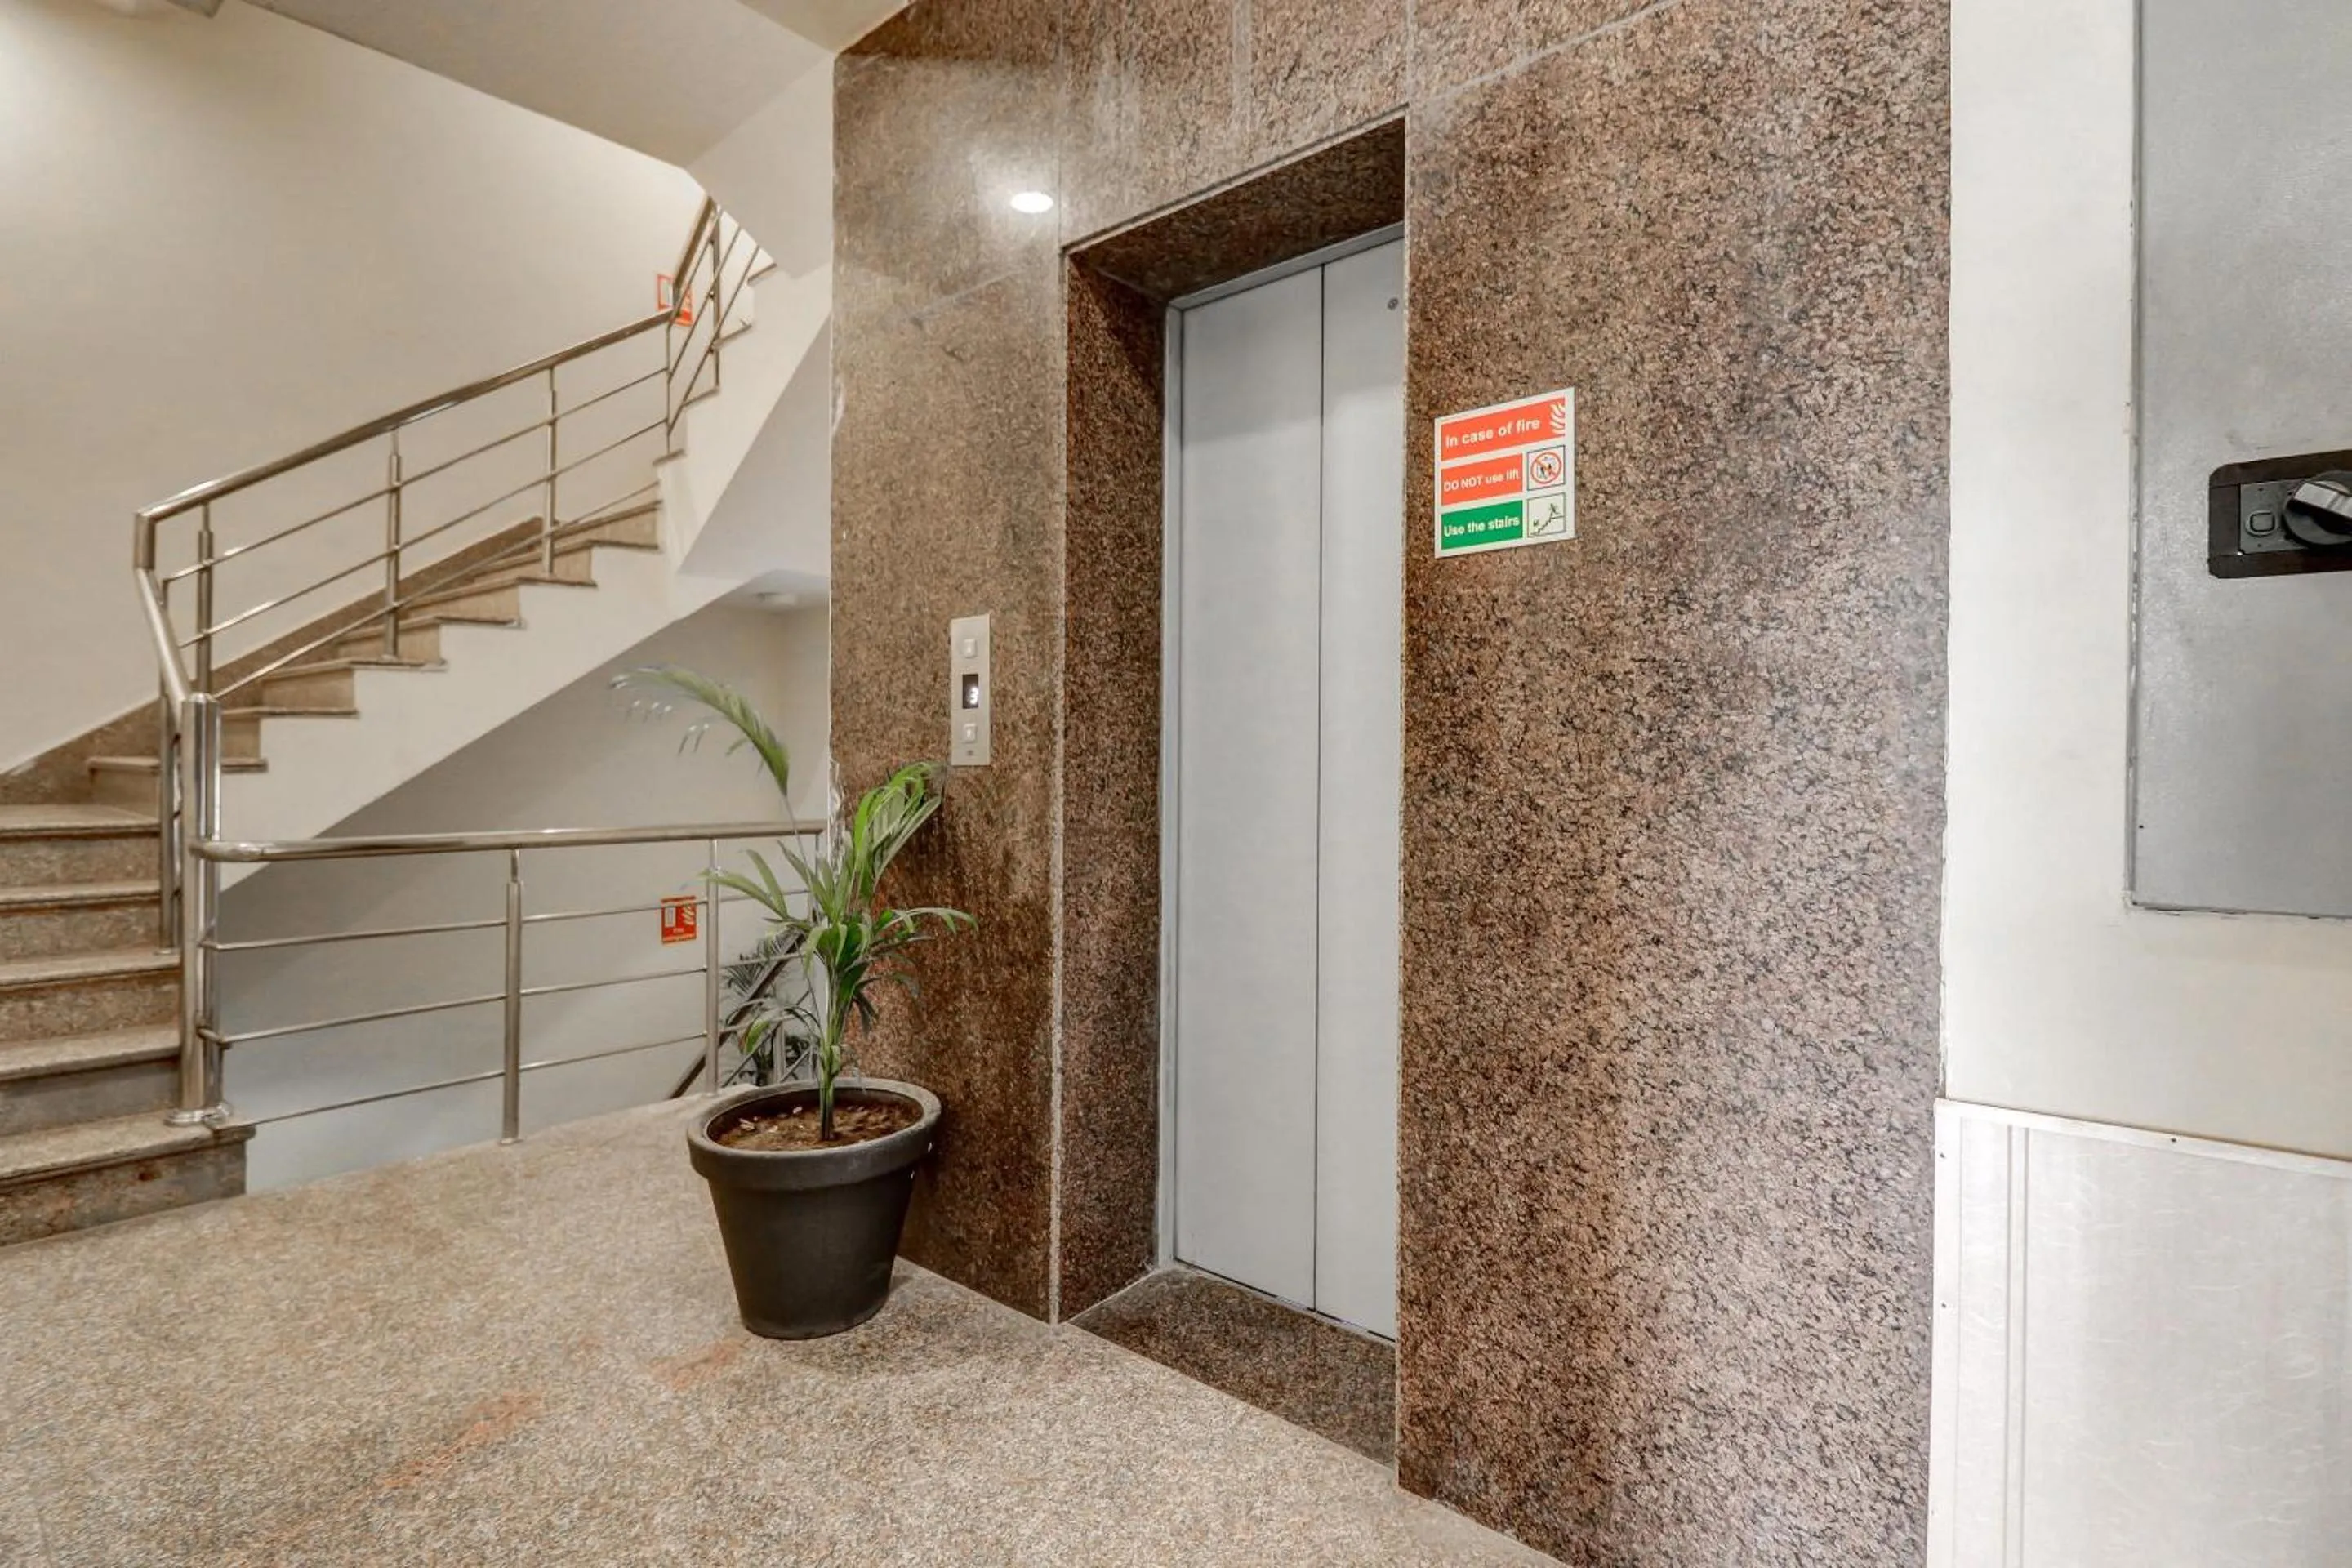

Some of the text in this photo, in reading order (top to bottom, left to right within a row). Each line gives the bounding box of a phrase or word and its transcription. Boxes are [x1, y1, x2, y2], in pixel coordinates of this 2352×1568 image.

[1445, 418, 1540, 448] In case of fire
[1443, 467, 1519, 492] DO NOT use lift
[1443, 515, 1520, 537] Use the stairs
